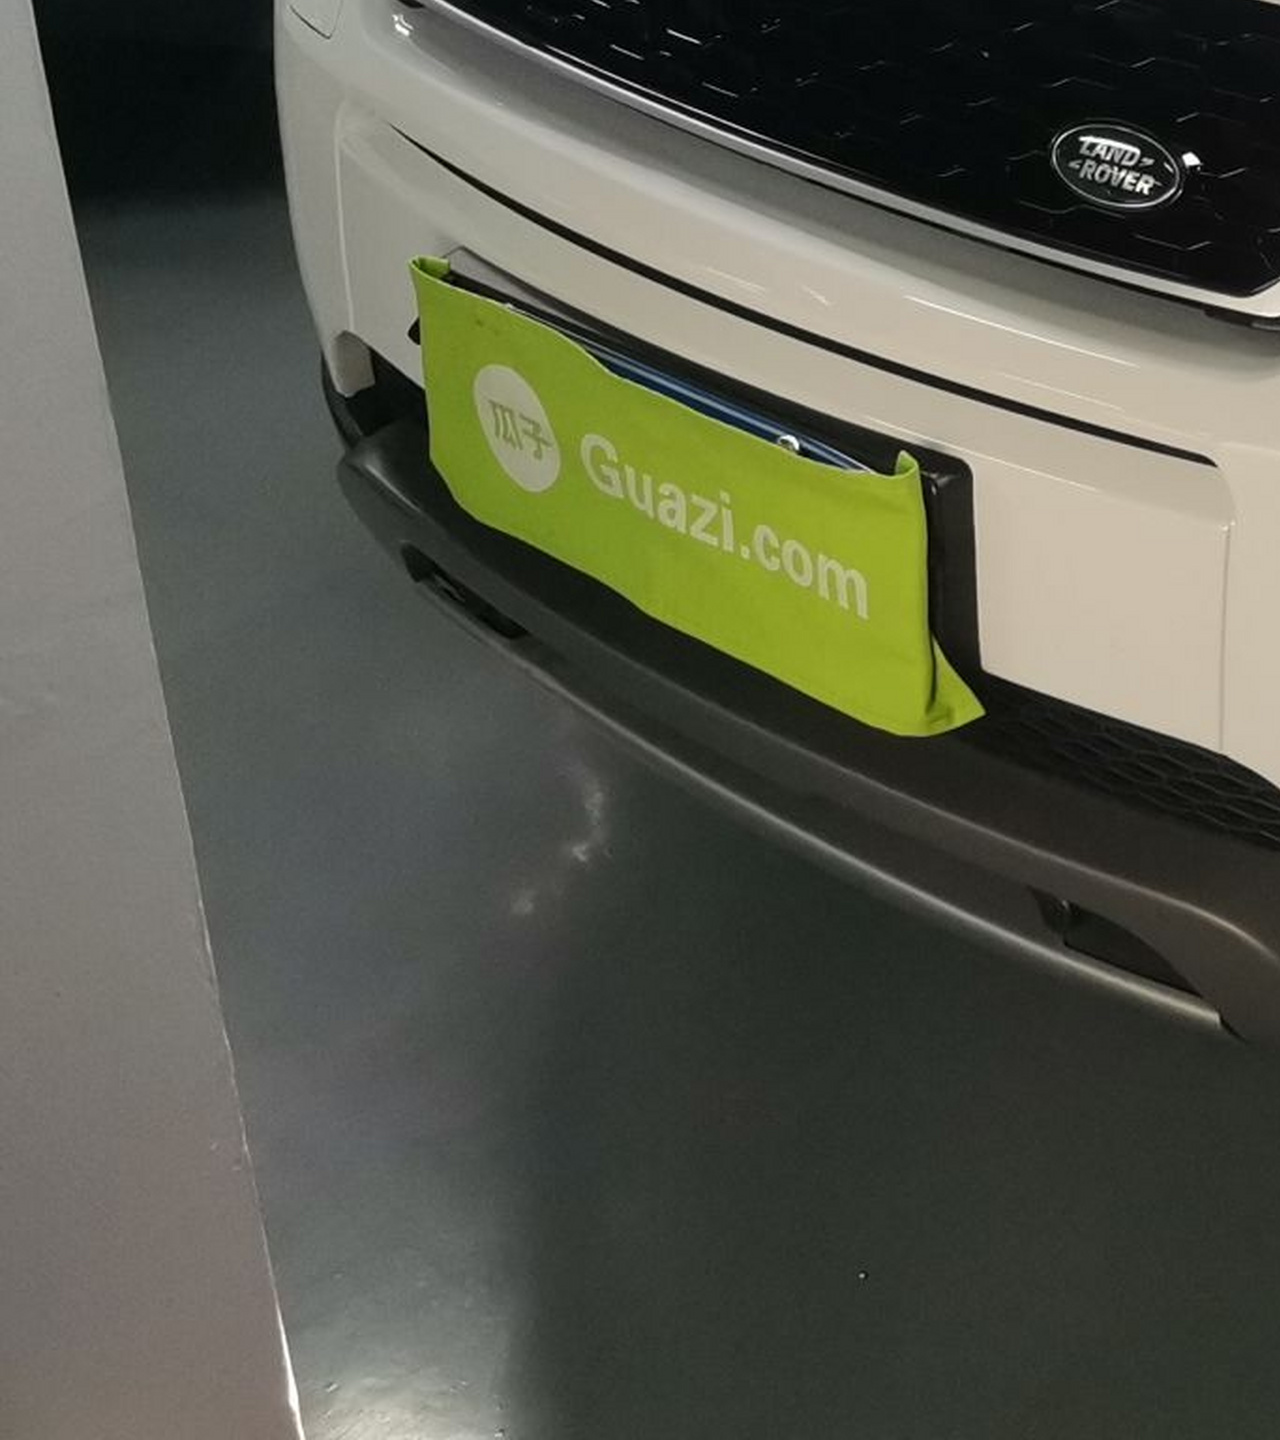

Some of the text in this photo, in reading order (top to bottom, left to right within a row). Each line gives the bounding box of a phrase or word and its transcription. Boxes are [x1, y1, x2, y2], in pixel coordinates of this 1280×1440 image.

[1078, 135, 1141, 166] LAND
[1079, 159, 1156, 195] ROVER
[488, 400, 554, 459] 瓜子
[580, 433, 869, 621] Guazi.com
